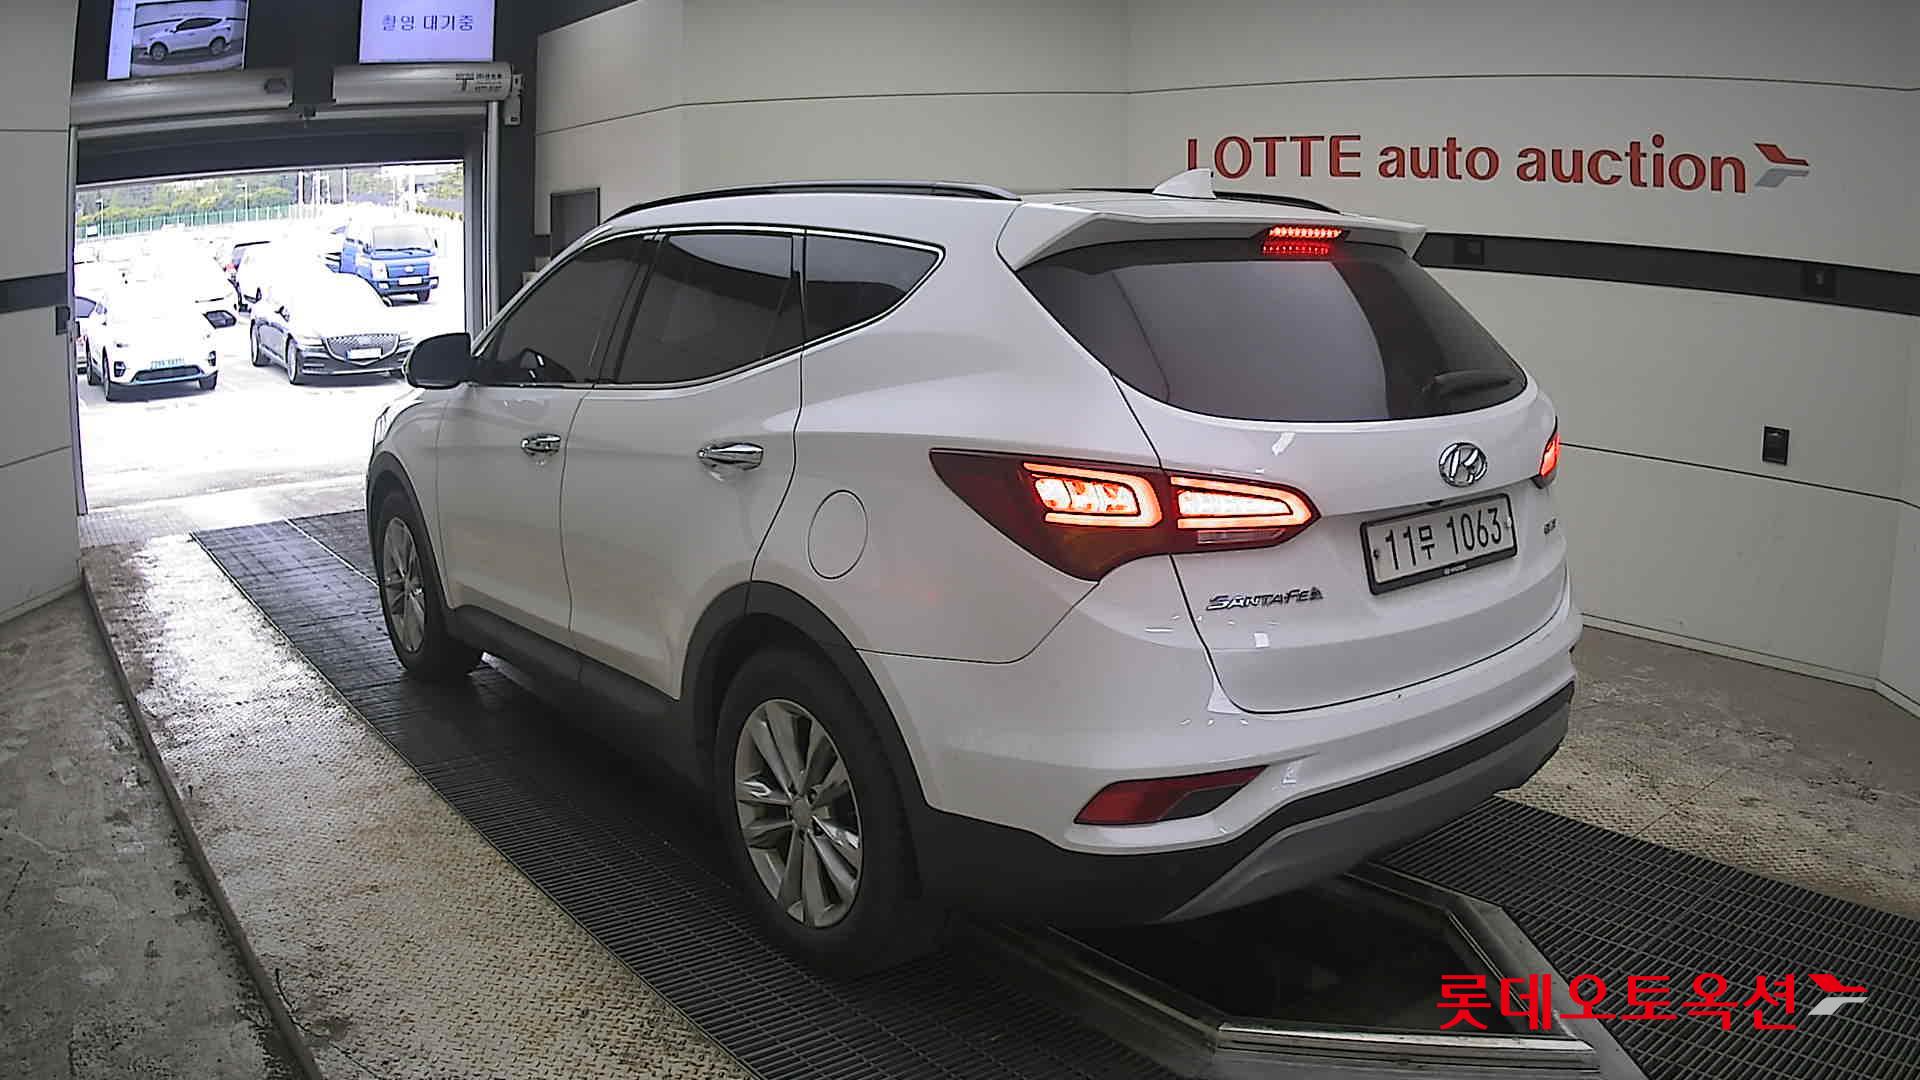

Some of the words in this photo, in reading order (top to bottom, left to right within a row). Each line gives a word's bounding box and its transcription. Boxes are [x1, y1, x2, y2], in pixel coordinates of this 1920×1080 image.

[423, 14, 473, 31] 대기중
[1188, 135, 1361, 179] LOTTE
[1378, 137, 1500, 181] auto
[1516, 134, 1746, 193] auction
[1385, 525, 1435, 570] 11무
[1446, 507, 1501, 554] 1063
